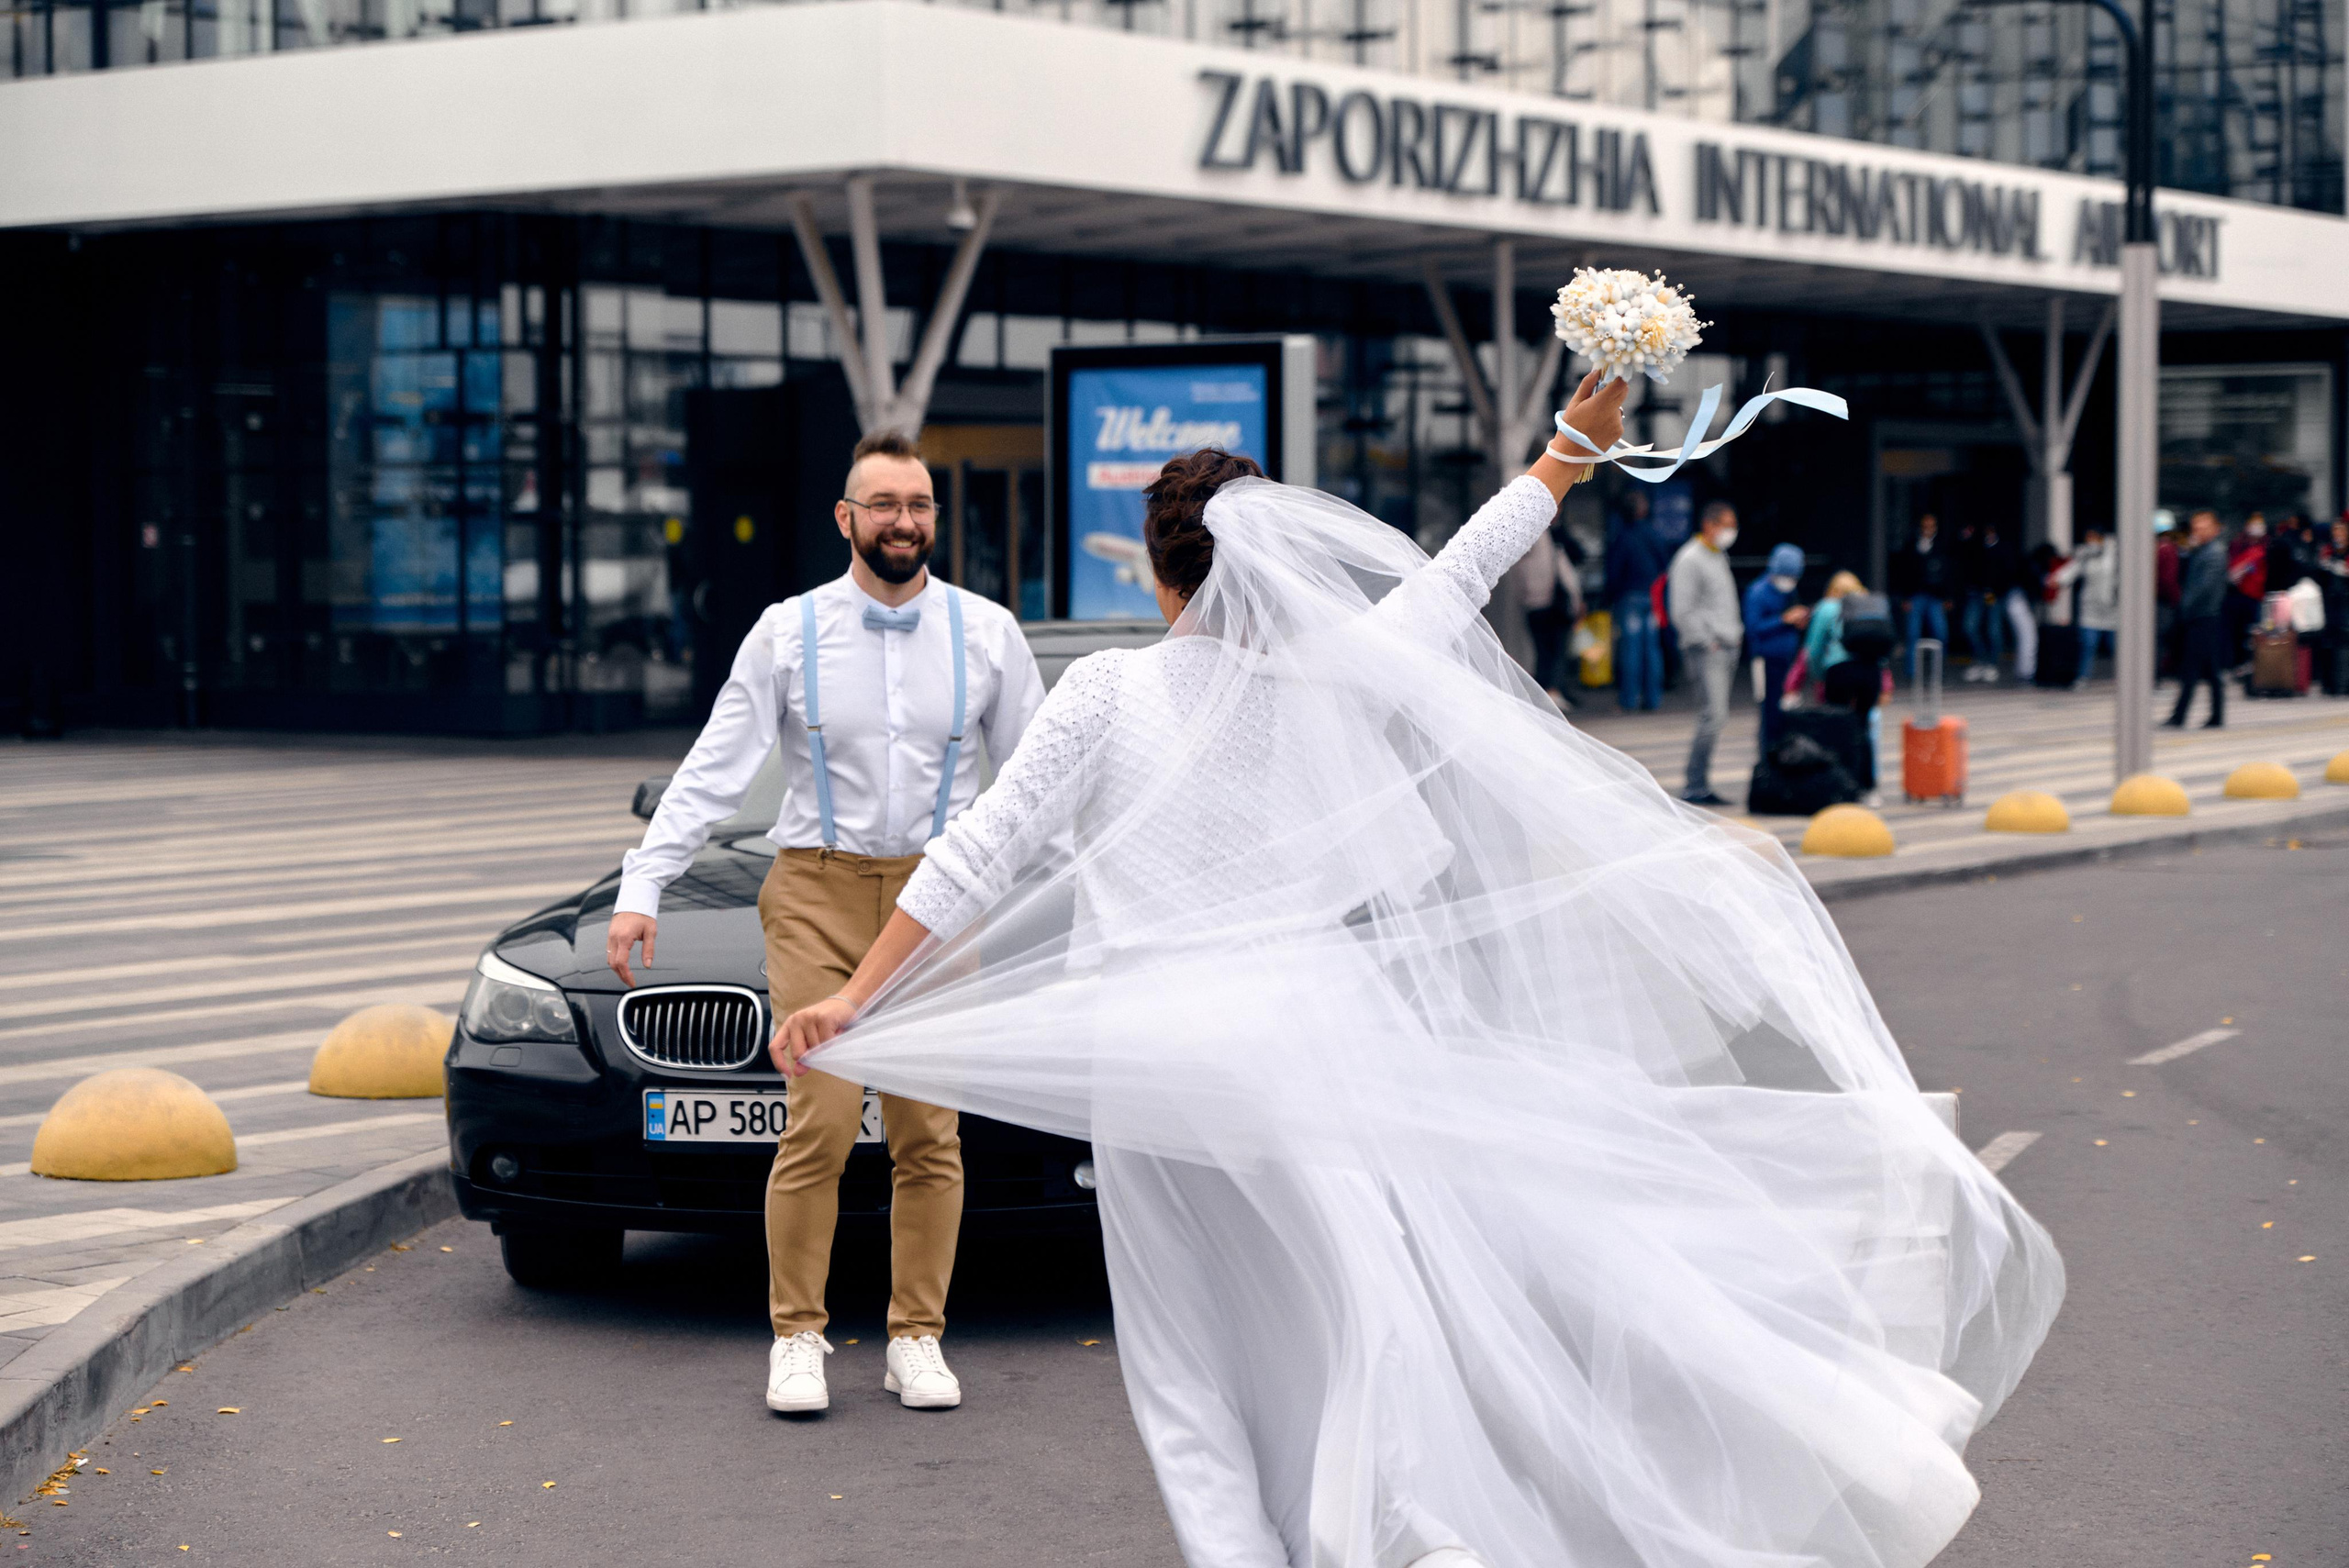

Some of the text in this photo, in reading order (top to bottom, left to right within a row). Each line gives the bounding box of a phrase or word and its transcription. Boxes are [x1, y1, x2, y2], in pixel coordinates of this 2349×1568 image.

[1197, 69, 1661, 216] ZAPORIZHZHIA
[1695, 141, 2052, 262] INTERNATIONAL
[1096, 406, 1242, 451] Welcome
[648, 1123, 665, 1135] UA
[669, 1100, 717, 1135] AP
